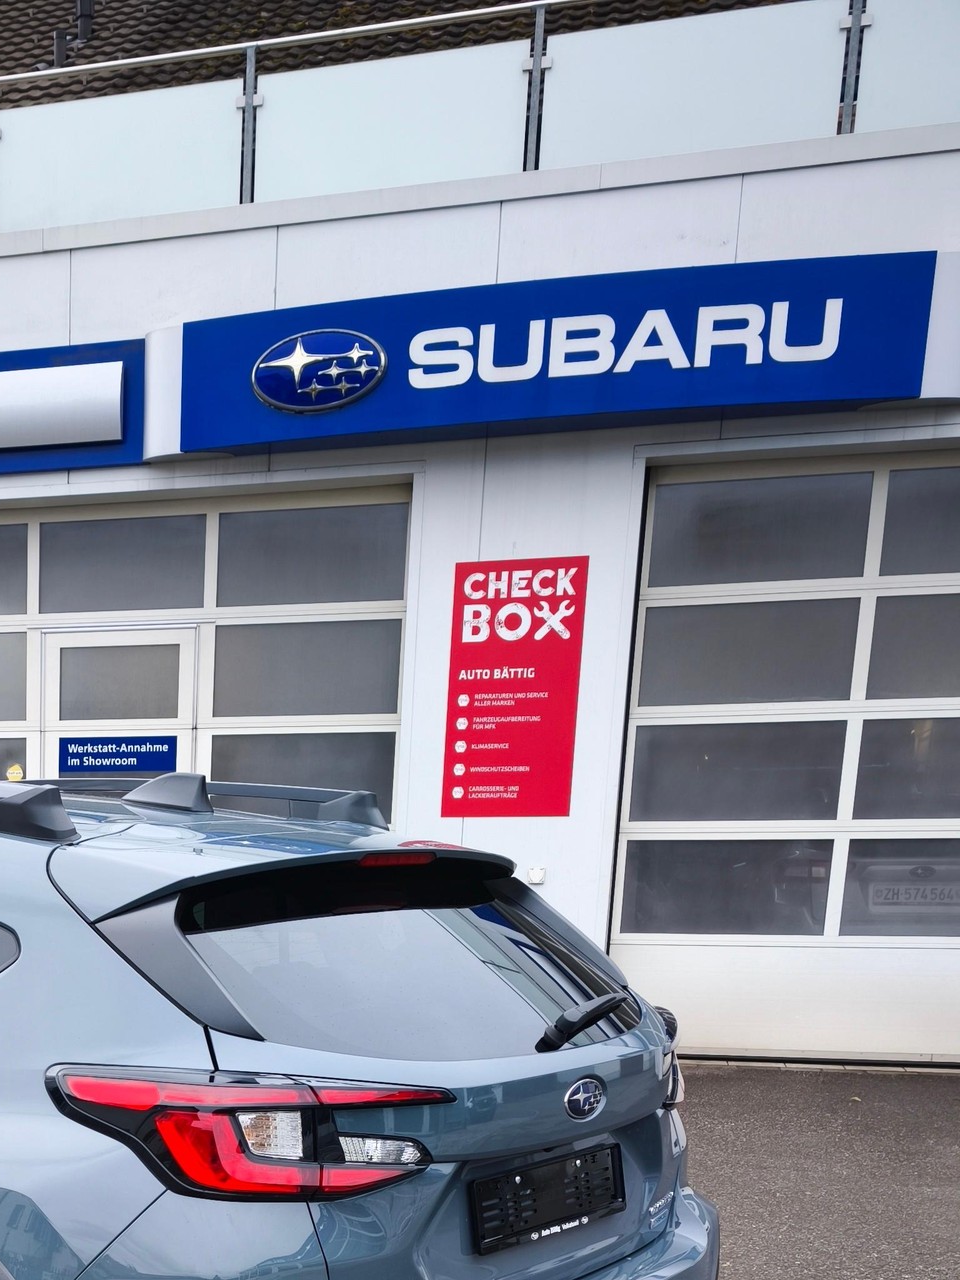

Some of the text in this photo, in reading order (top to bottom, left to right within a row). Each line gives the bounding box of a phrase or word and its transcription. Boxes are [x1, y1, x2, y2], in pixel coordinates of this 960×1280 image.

[407, 297, 844, 391] SUBARU
[463, 567, 579, 600] CHECK
[461, 600, 576, 643] BOX
[458, 666, 536, 680] AUTO BÄTTIG
[474, 692, 514, 700] REPARATUREN
[526, 691, 549, 699] SERVICE
[67, 742, 169, 754] Werkstatt-Annahme
[67, 756, 137, 766] im Showroom
